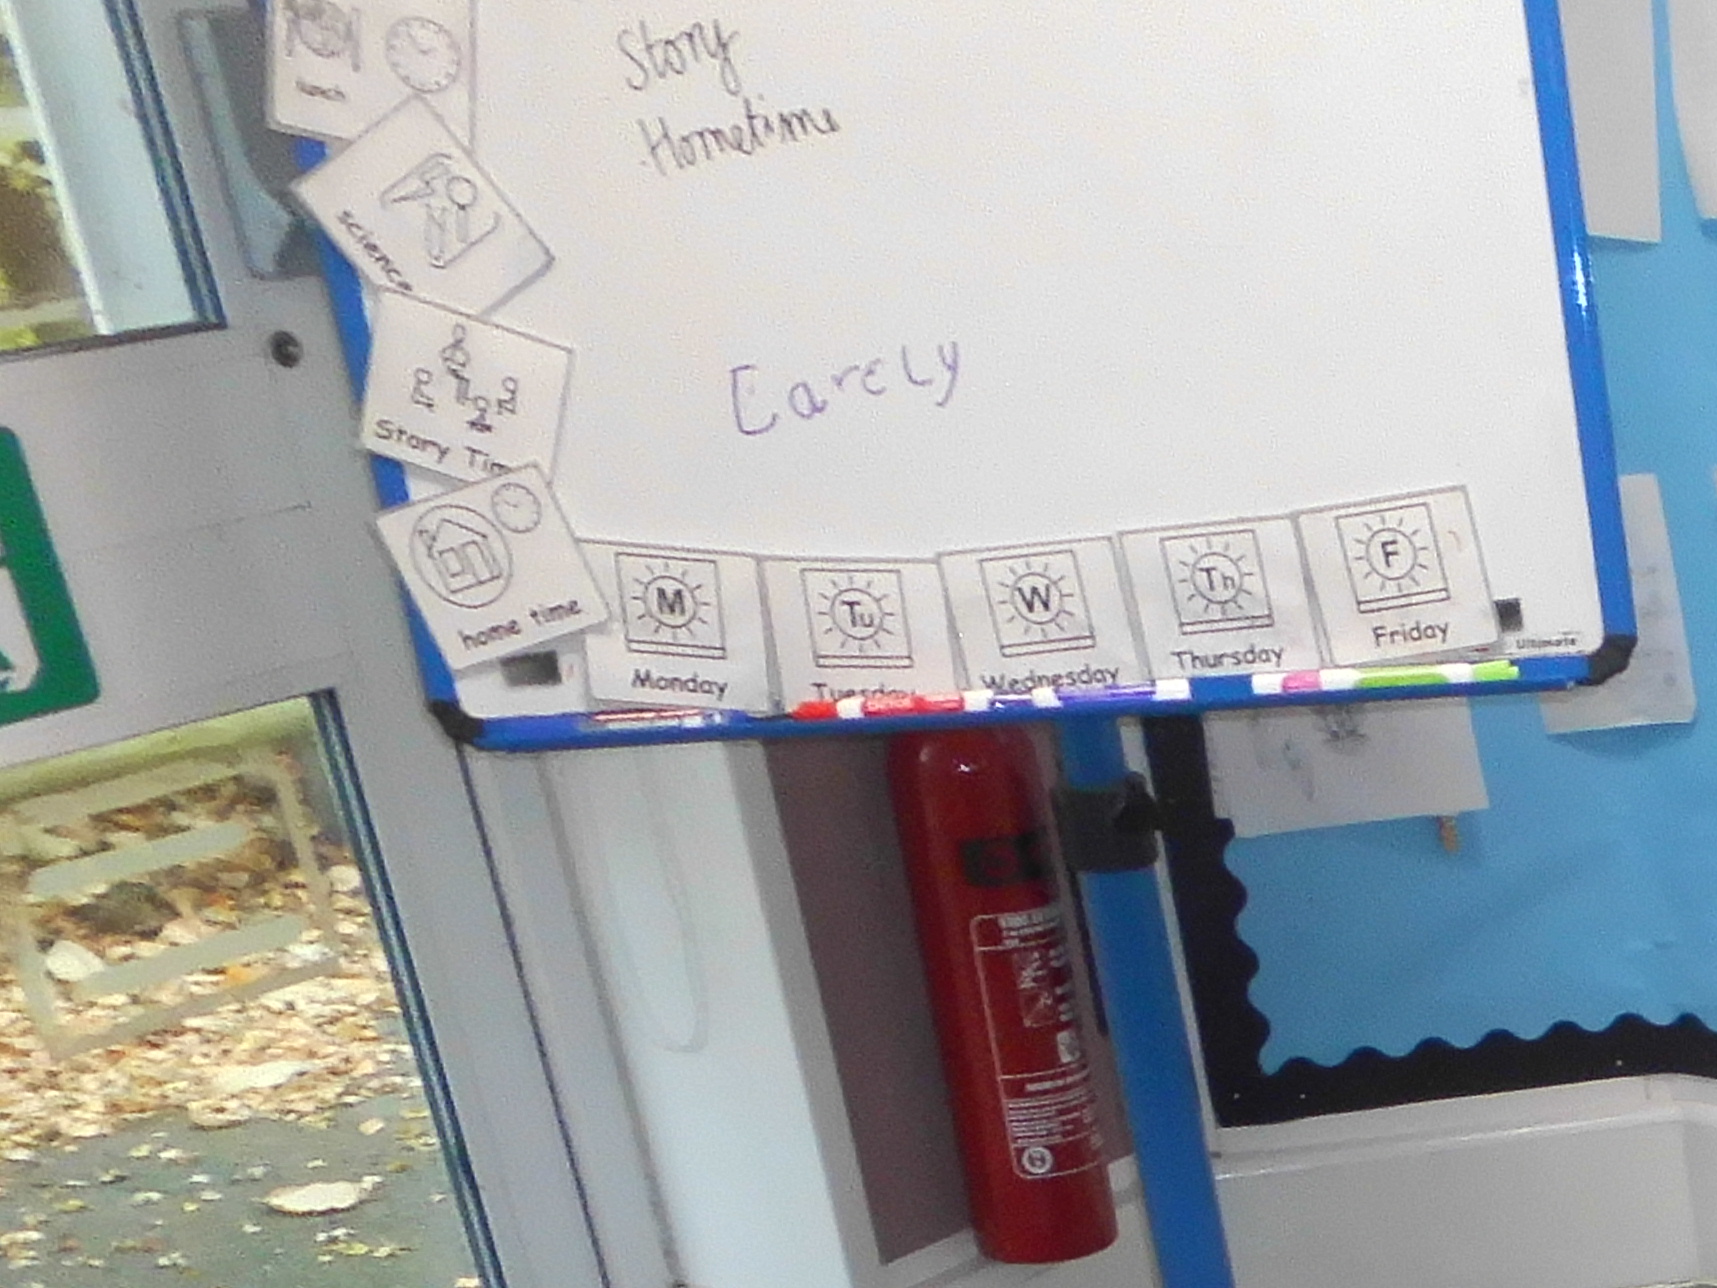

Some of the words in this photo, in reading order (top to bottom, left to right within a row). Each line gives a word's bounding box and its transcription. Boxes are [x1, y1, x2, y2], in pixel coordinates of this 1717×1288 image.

[617, 18, 742, 96] Story
[375, 419, 450, 464] Story
[1379, 540, 1399, 569] F
[1194, 565, 1236, 593] Th
[655, 586, 687, 617] M
[841, 598, 875, 628] Tu
[1017, 584, 1052, 614] W
[458, 618, 523, 650] home
[528, 599, 584, 626] time
[1372, 619, 1450, 648] Friday
[1171, 644, 1287, 671] Thursday
[631, 668, 728, 700] Monday
[980, 664, 1120, 693] Wednesday
